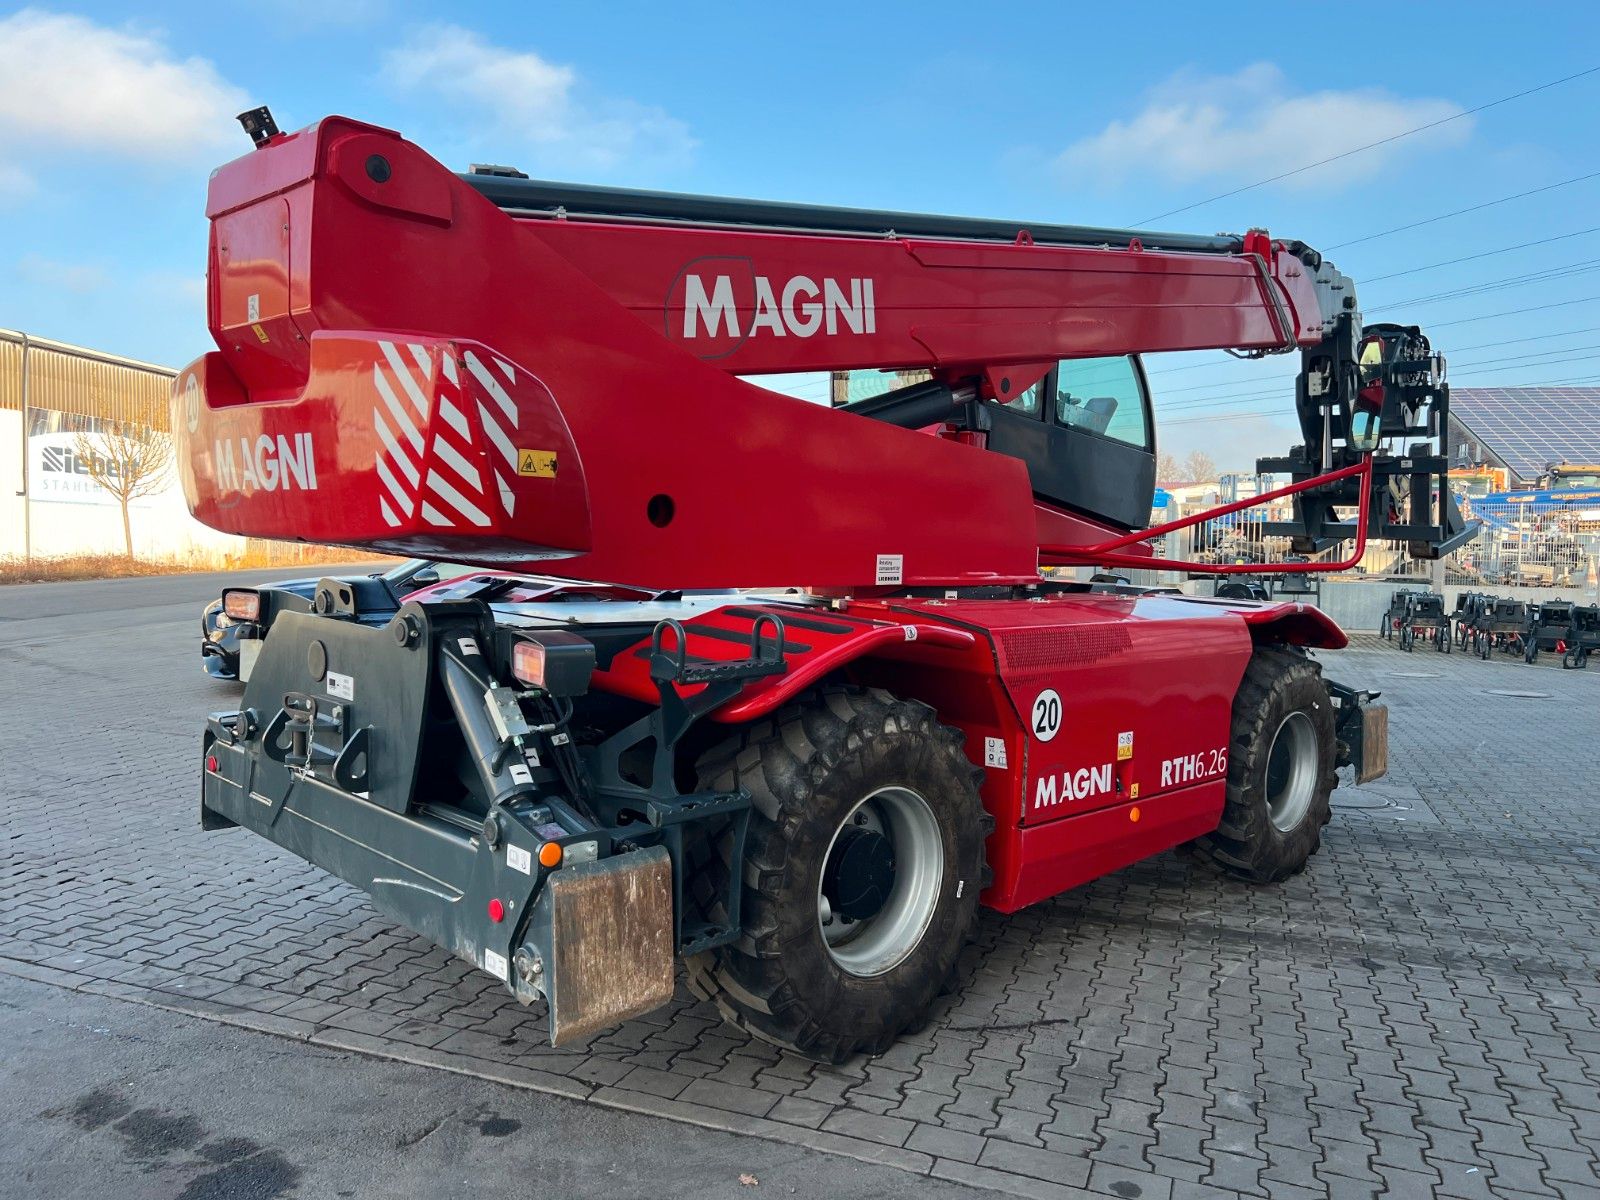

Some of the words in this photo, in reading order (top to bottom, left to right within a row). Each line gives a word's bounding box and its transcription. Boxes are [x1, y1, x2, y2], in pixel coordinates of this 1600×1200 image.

[683, 275, 876, 338] MAGNI
[215, 432, 318, 491] MAGNI
[1035, 697, 1058, 733] 20
[1034, 763, 1112, 809] MAGNI
[1160, 747, 1227, 787] RTH6.26
